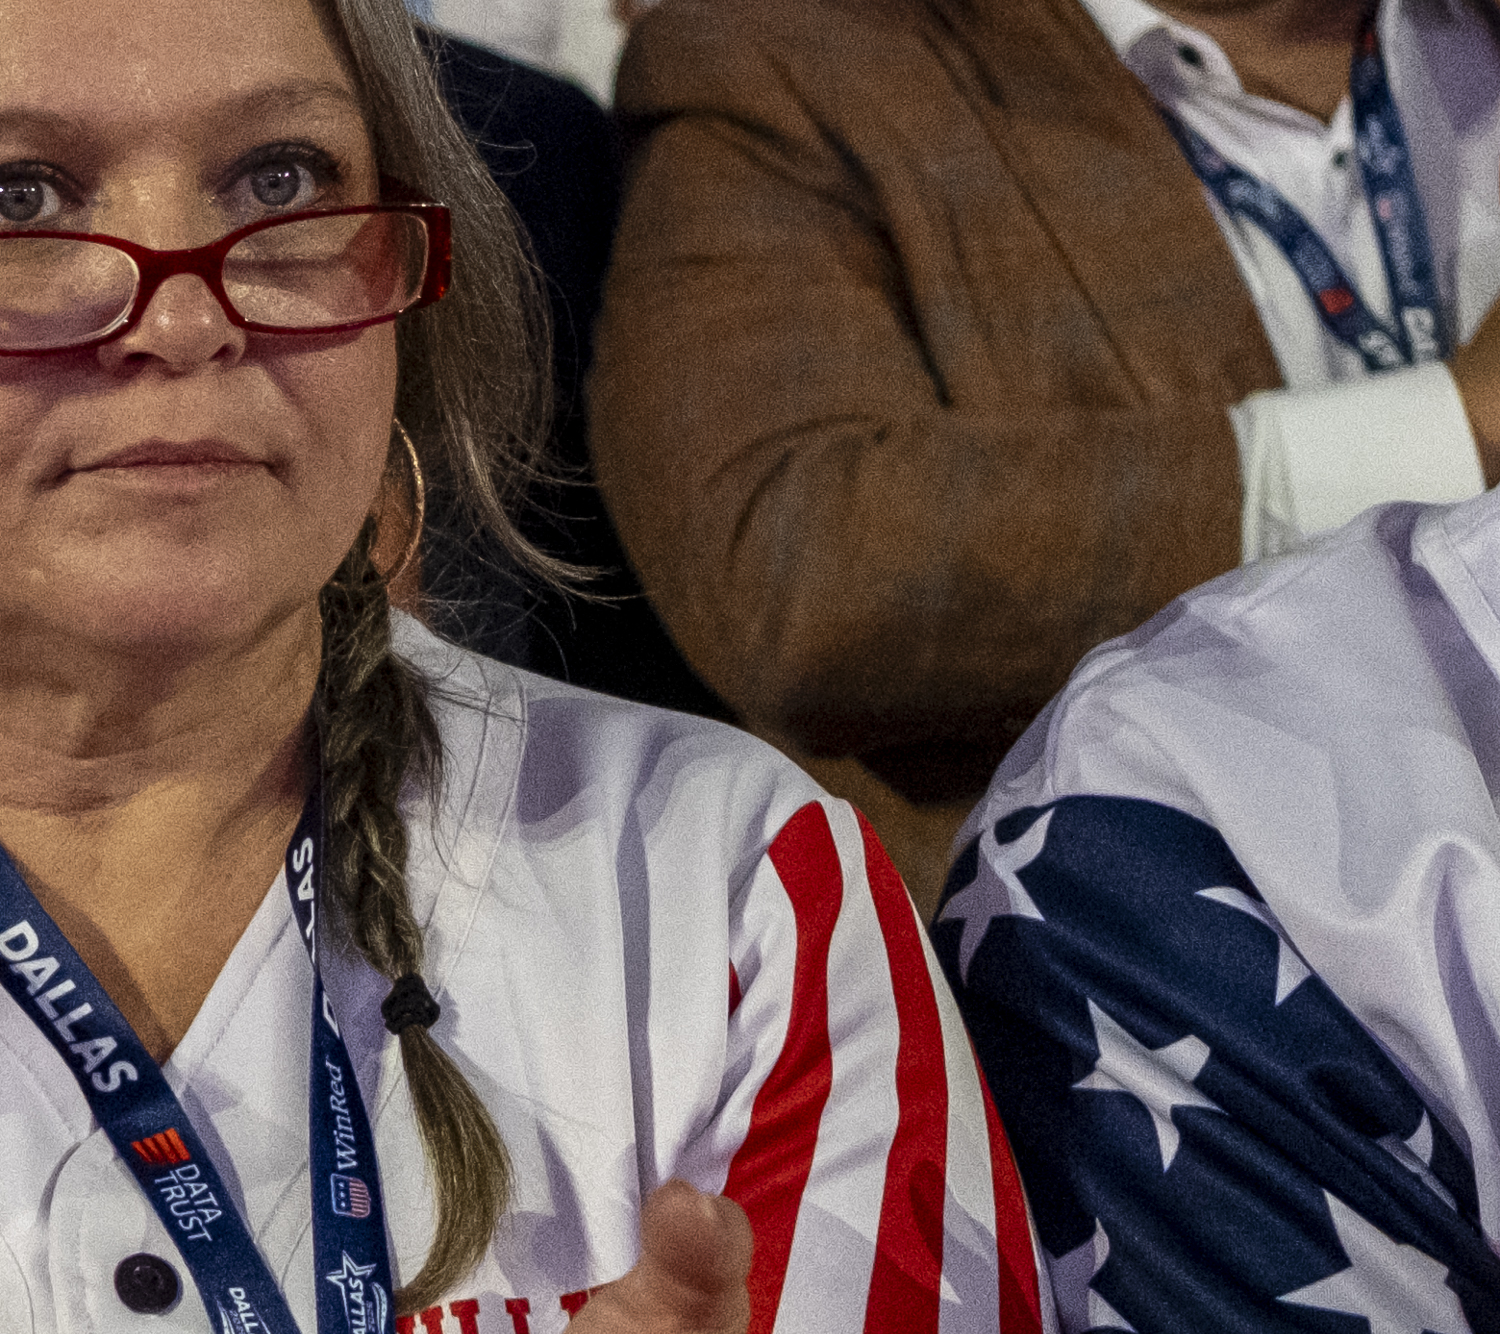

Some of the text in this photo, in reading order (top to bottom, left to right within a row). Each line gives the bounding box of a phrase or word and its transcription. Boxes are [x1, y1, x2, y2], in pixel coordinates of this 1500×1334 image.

[329, 1063, 360, 1171] WinRed
[153, 1172, 213, 1243] TRUST
[169, 1163, 223, 1225] DATA
